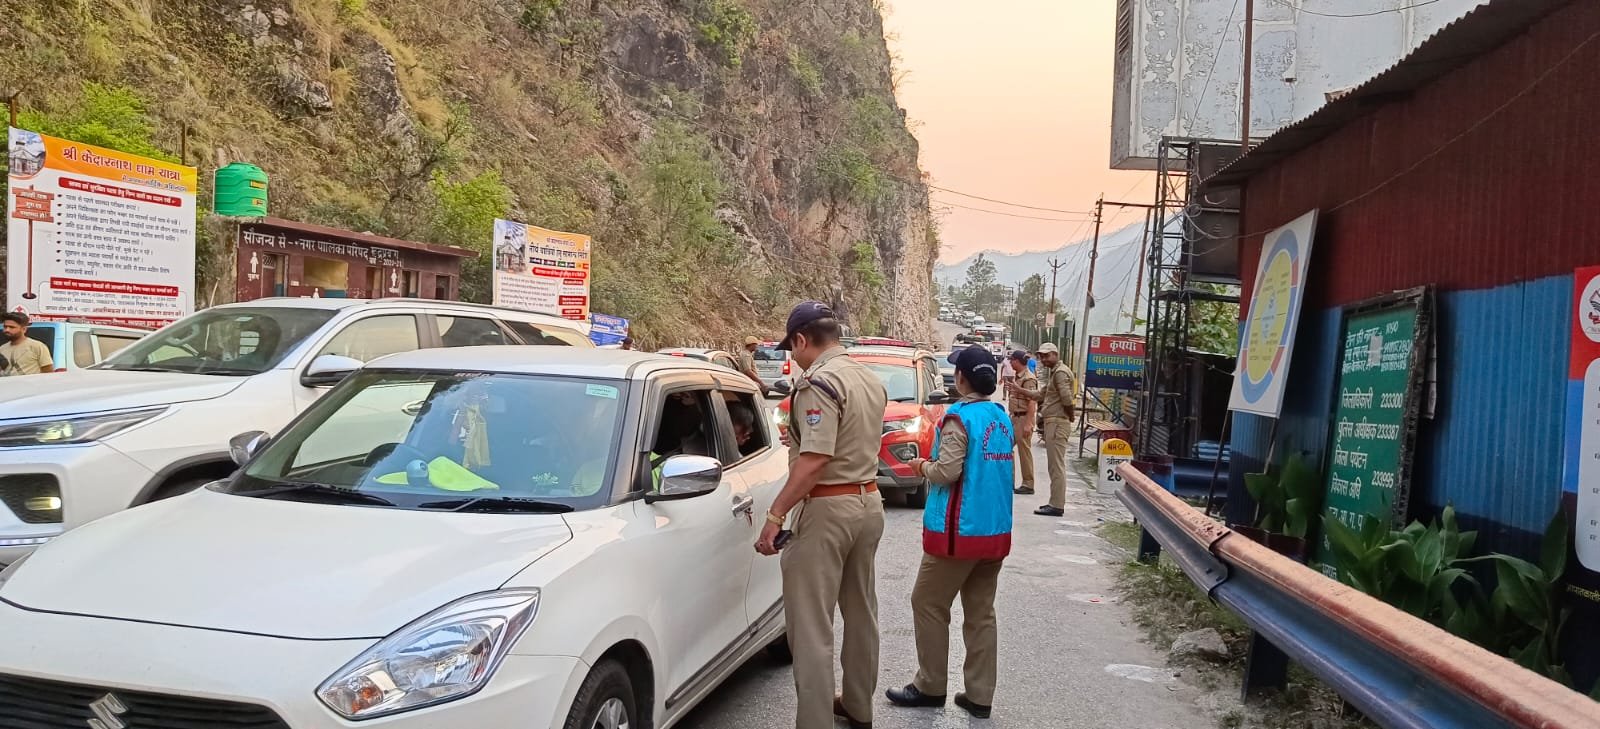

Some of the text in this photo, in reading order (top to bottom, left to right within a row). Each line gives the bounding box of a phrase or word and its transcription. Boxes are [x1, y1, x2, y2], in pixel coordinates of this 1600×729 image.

[63, 146, 180, 181] श्री केदारनाथ धाम यात्रा
[243, 227, 275, 248] सौजन्य
[278, 232, 287, 248] से
[299, 238, 316, 251] नगर
[1110, 340, 1137, 352] कृपया
[1380, 393, 1403, 408] 233300
[1337, 417, 1354, 441] पुलिस
[1377, 425, 1399, 440] 233387
[1335, 444, 1368, 469] जिला पर्यटन
